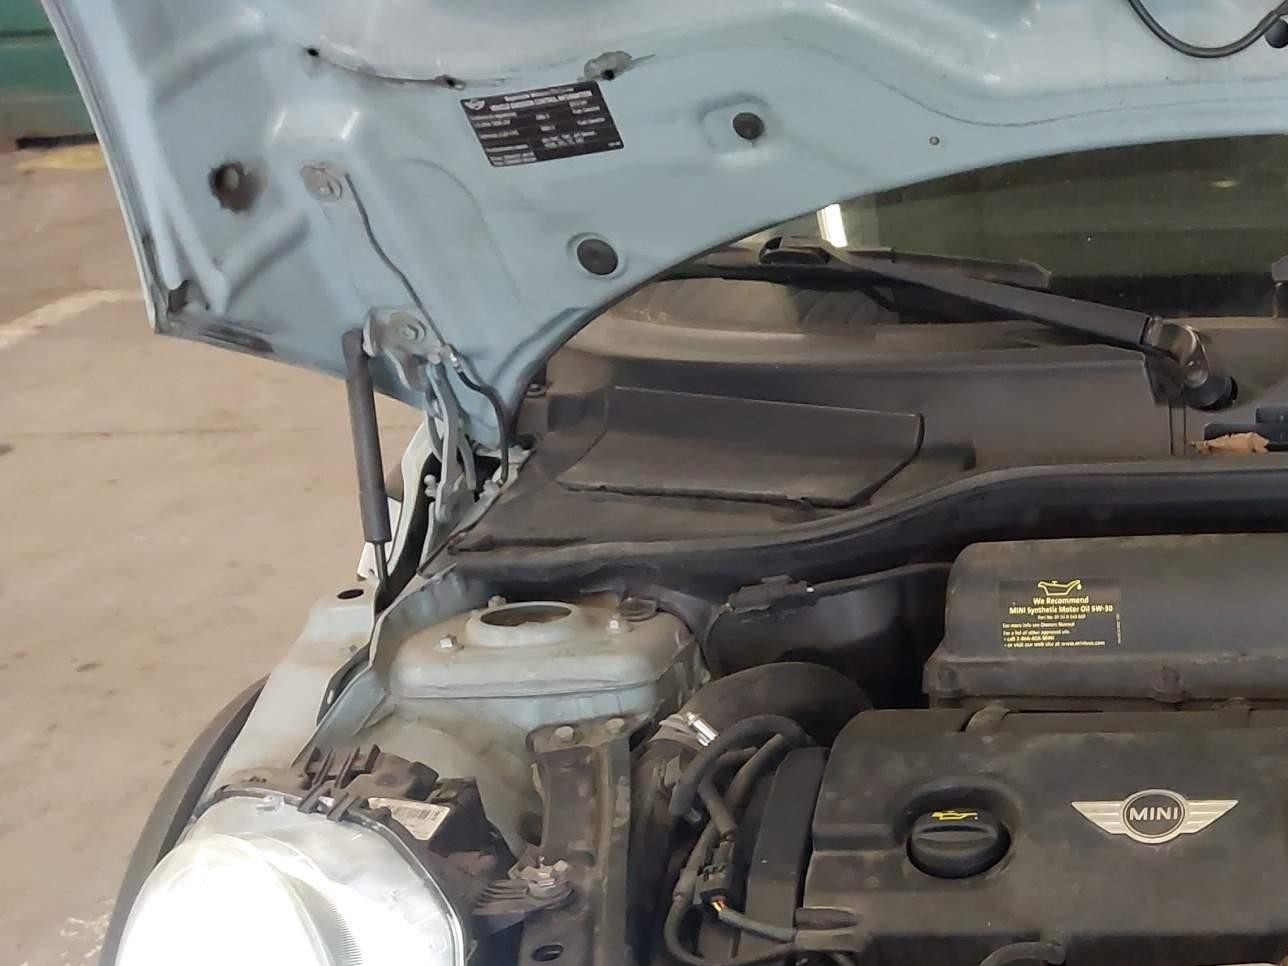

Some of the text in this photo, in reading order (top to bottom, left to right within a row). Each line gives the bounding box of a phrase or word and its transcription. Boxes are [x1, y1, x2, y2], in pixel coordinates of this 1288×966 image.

[1033, 595, 1089, 605] We Recommend
[1009, 604, 1113, 616] MINI Synthetic Motor Oil 5W-30
[1129, 806, 1179, 821] MINI
